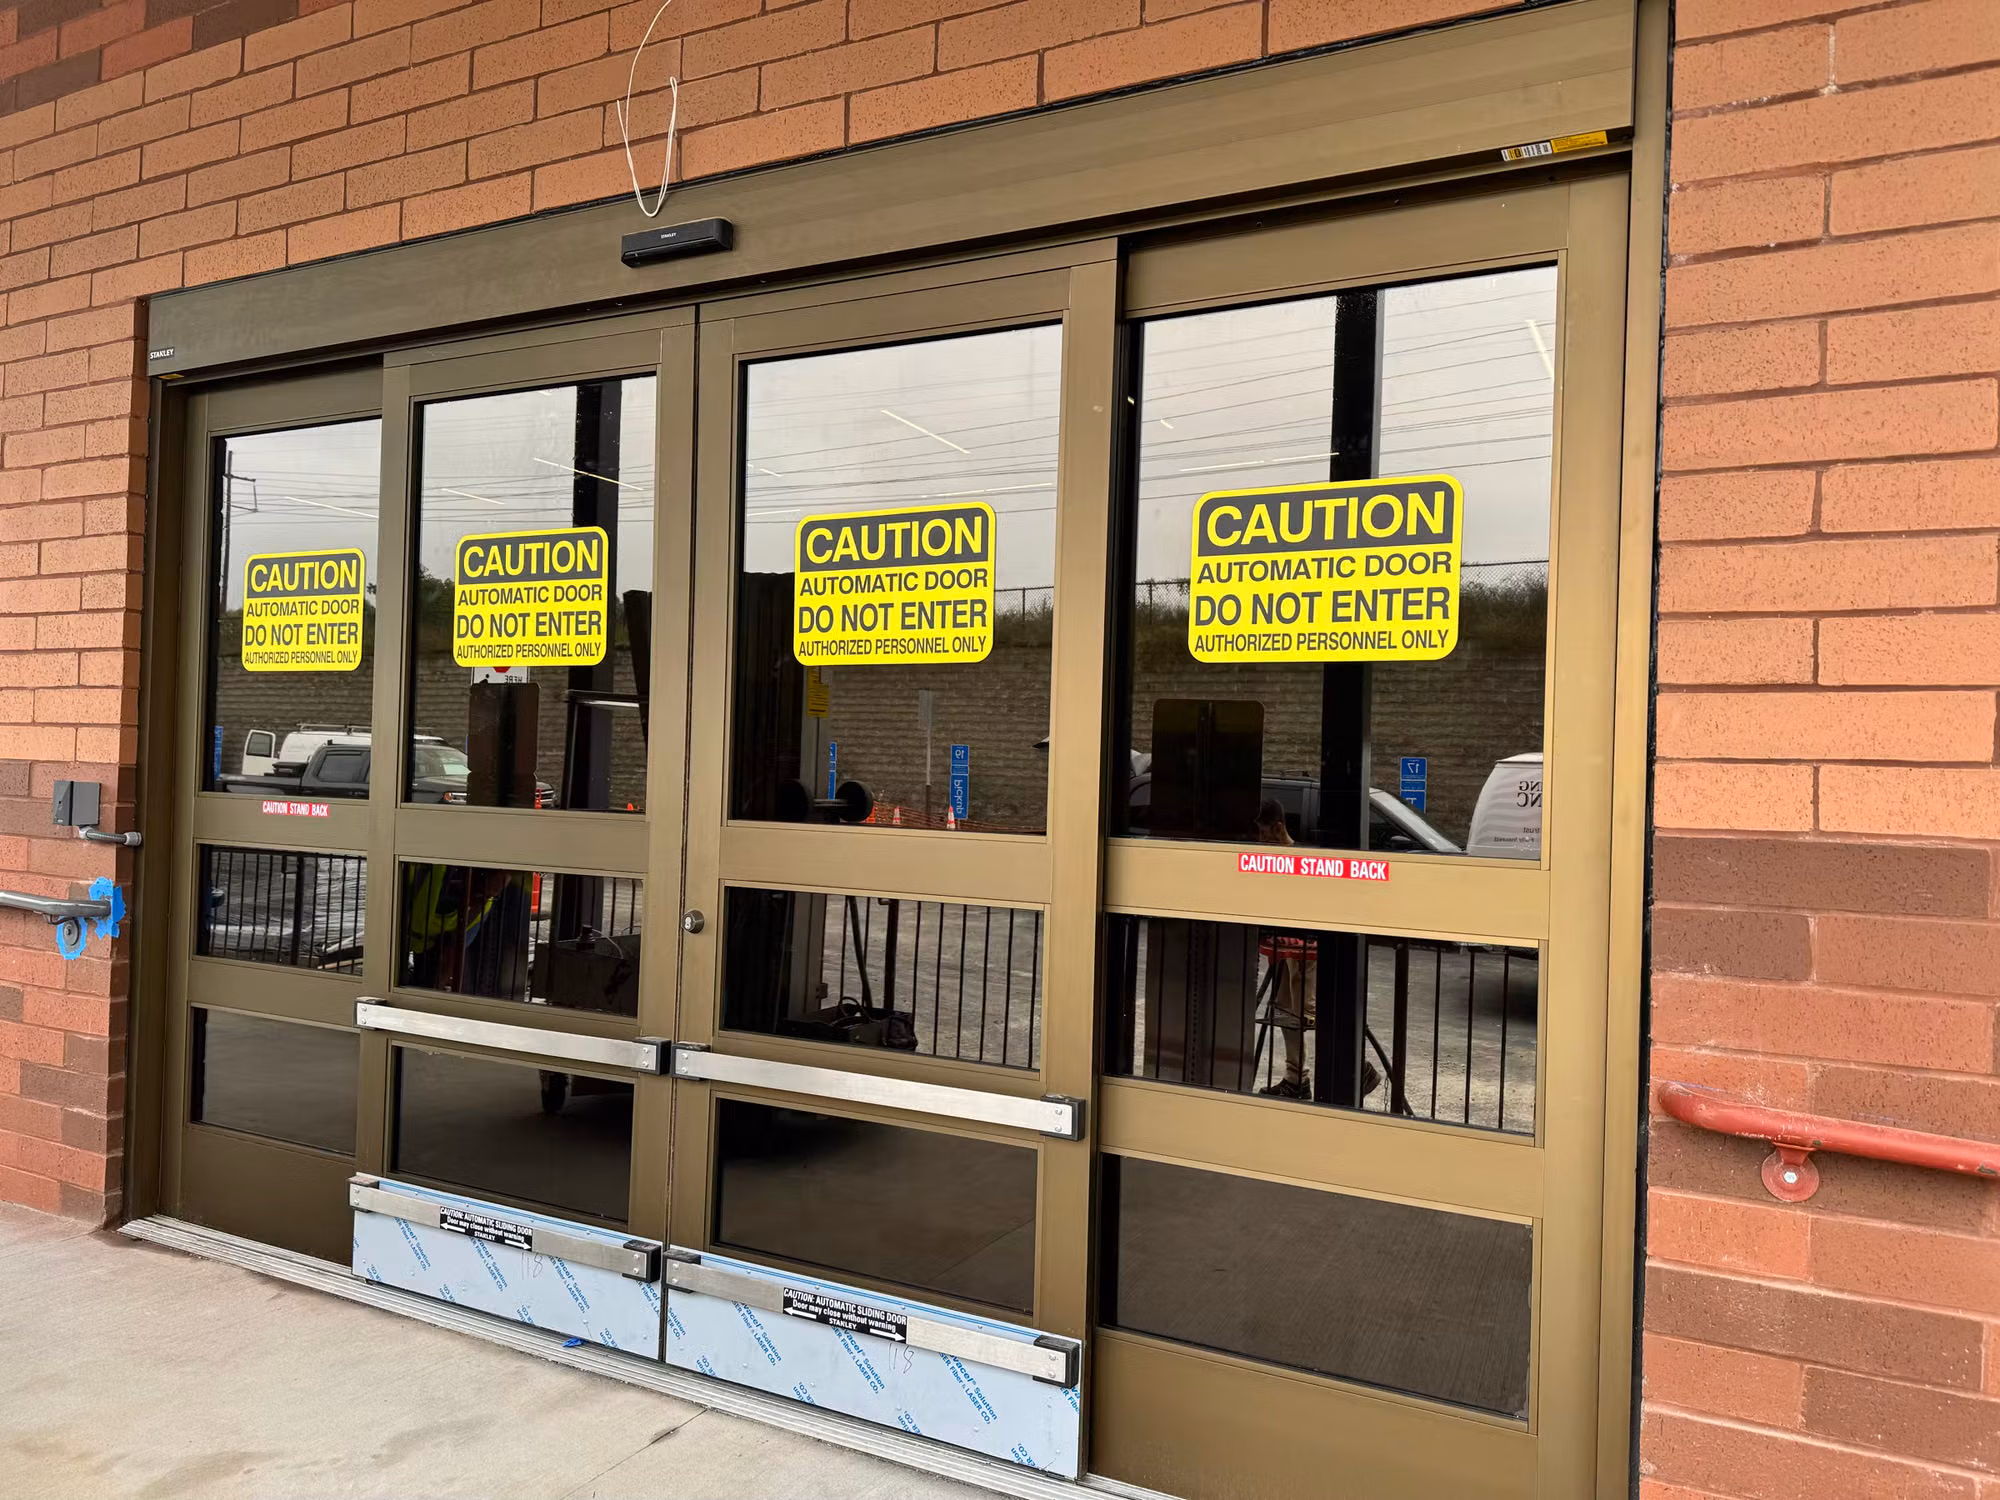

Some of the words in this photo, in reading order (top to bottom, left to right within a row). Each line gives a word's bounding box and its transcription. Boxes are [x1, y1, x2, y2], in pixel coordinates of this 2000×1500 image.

[150, 348, 174, 360] STANLEY
[1206, 490, 1445, 547] CAUTION
[806, 516, 982, 564] CAUTION
[463, 539, 598, 578] CAUTION
[1197, 555, 1356, 584] AUTOMATIC
[1364, 551, 1452, 578] DOOR
[250, 560, 357, 592] CAUTION
[800, 572, 918, 596] AUTOMATIC
[924, 568, 988, 590] DOOR
[246, 601, 318, 618] AUTOMATIC
[321, 599, 359, 615] DOOR
[458, 586, 550, 606] AUTOMATIC
[553, 584, 602, 602] DOOR
[1195, 594, 1242, 627] DO
[1251, 591, 1322, 625] NOT
[1331, 586, 1450, 623] ENTER
[456, 614, 484, 638] DO
[490, 612, 530, 638] NOT
[535, 610, 602, 636] ENTER
[798, 605, 834, 634] DO
[841, 602, 894, 632] NOT
[901, 598, 987, 630] ENTER
[245, 624, 266, 646] DO
[270, 624, 303, 646] NOT
[306, 622, 358, 644] ENTER
[798, 640, 872, 656] AUTHORIZED
[875, 636, 949, 655] PERSONNEL
[952, 636, 987, 654] ONLY
[1194, 633, 1292, 652] AUTHORIZED
[1296, 630, 1397, 651] PERSONNEL
[1401, 629, 1449, 649] ONLY
[244, 651, 289, 664] AUTHORIZED
[290, 651, 336, 664] PERSONNEL
[336, 650, 358, 664] ONLY
[456, 644, 514, 659] AUTHORIZED
[516, 643, 572, 658] PERSONNEL
[574, 642, 601, 657] ONLY
[262, 801, 288, 814] CAUTION
[290, 803, 310, 814] STAND
[312, 804, 328, 816] BACK
[1240, 854, 1294, 874] CAUTION
[1300, 858, 1344, 877] STAND
[1350, 860, 1386, 880] BACK
[464, 1213, 494, 1227] AUTOMATIC
[496, 1220, 516, 1232] SLIDING
[516, 1225, 532, 1236] DOOR
[474, 1231, 495, 1240] STANLEY
[504, 1231, 524, 1242] warning
[668, 1307, 686, 1336] Solution
[792, 1300, 808, 1309] Door
[808, 1305, 822, 1314] may
[823, 1308, 841, 1318] close
[842, 1312, 867, 1324] without
[868, 1319, 896, 1333] warning
[816, 1296, 856, 1313] AUTOMATIC
[857, 1306, 885, 1320] SLIDING
[886, 1312, 906, 1326] DOOR
[829, 1318, 858, 1330] STANLEY
[754, 1333, 769, 1354] LASER
[762, 1332, 782, 1362] Solution
[855, 1360, 872, 1382] LASER
[863, 1358, 886, 1390] Solution
[950, 1366, 964, 1384] Fiber
[965, 1388, 982, 1412] LASER
[974, 1387, 998, 1420] Solution
